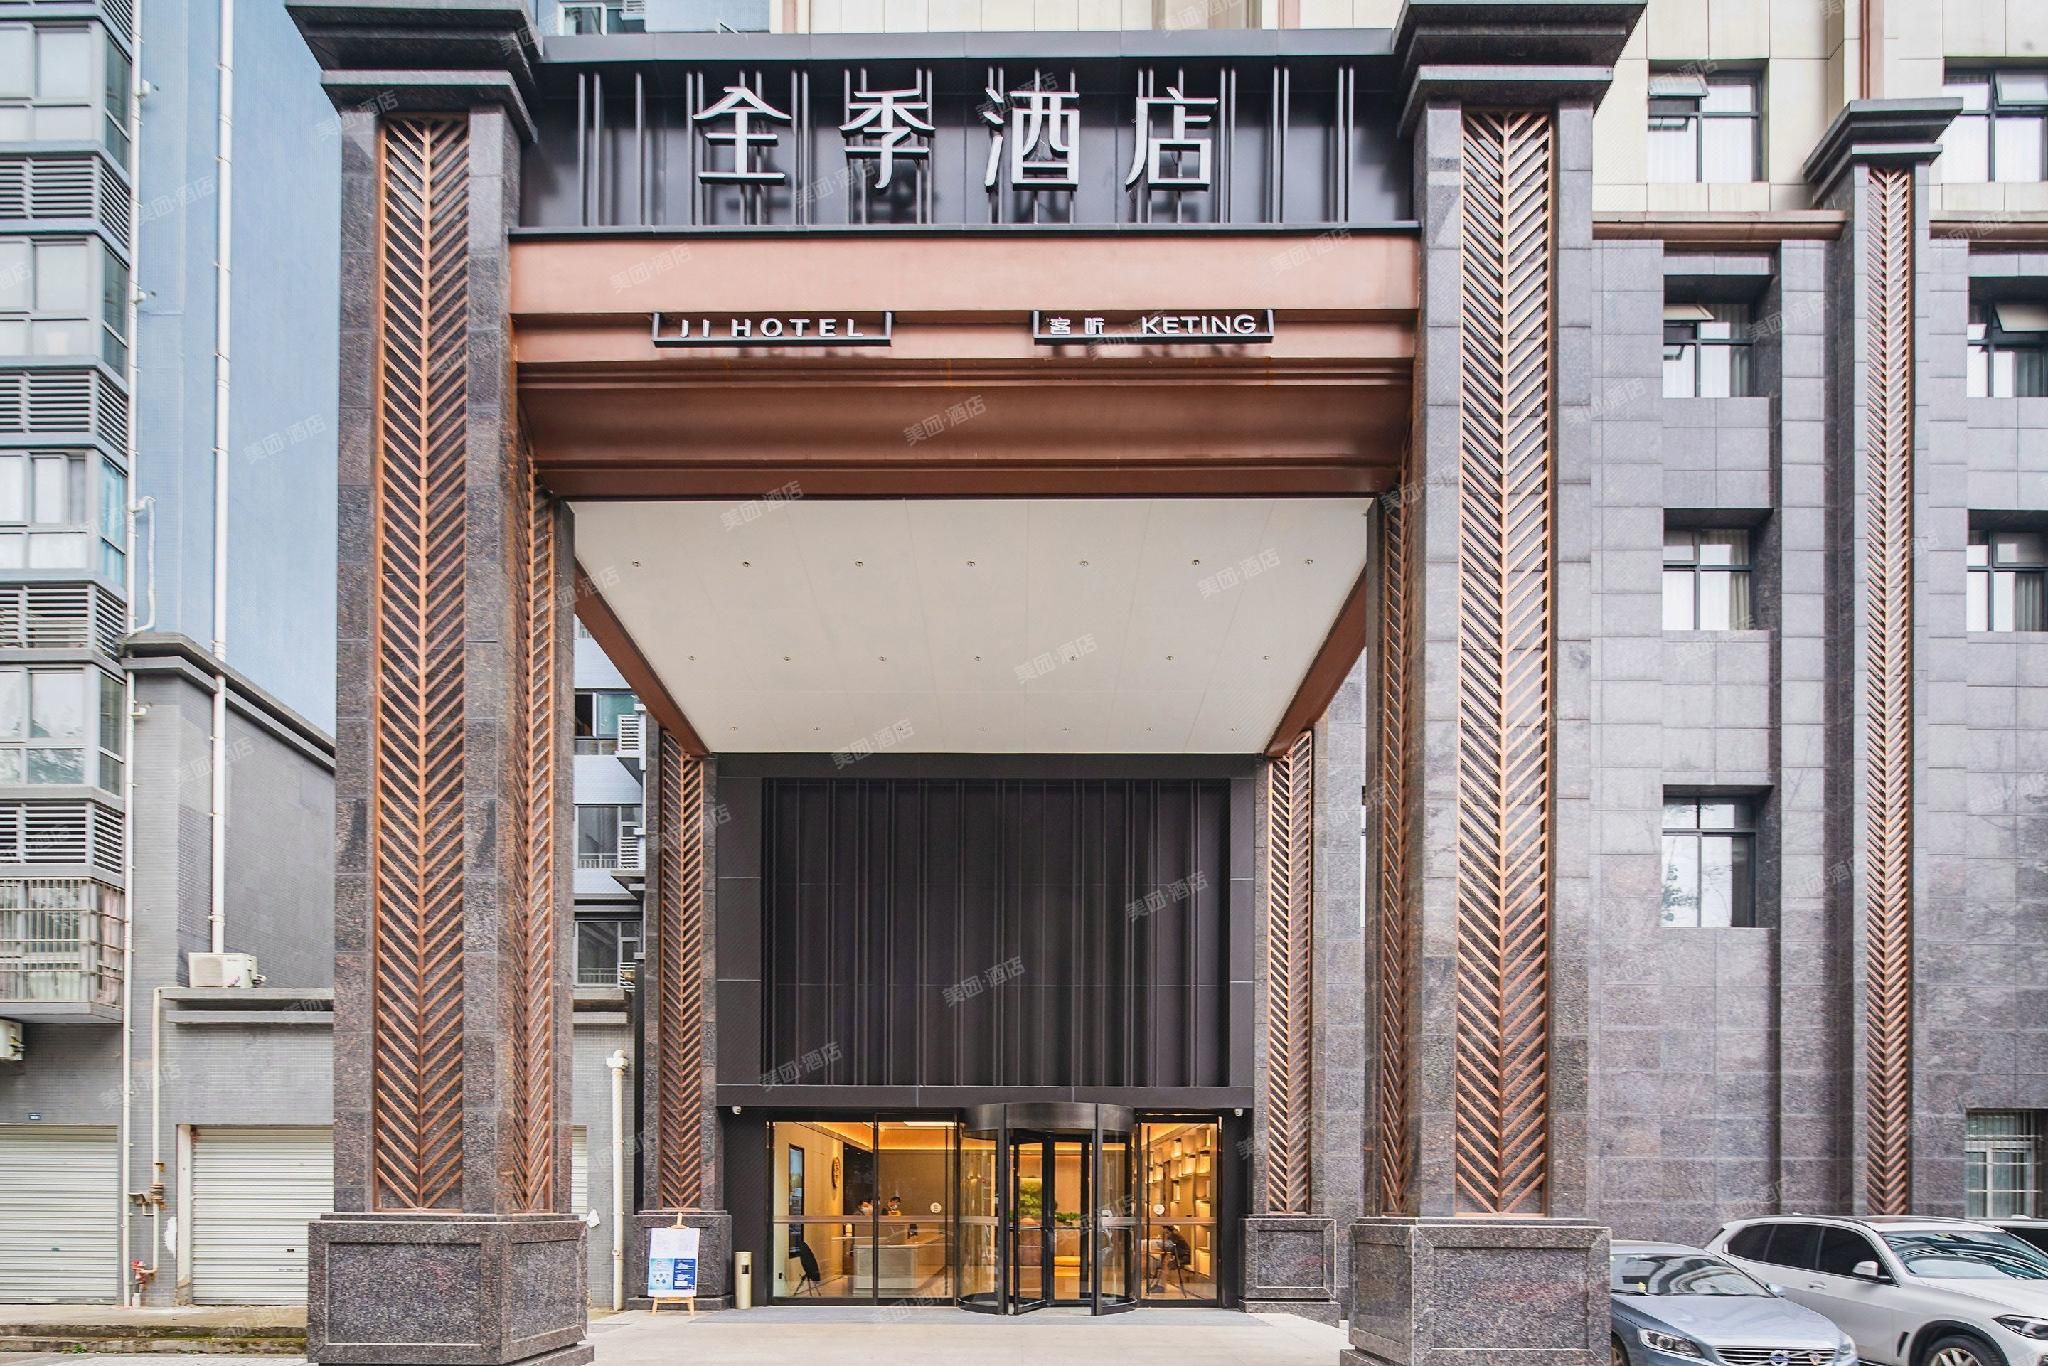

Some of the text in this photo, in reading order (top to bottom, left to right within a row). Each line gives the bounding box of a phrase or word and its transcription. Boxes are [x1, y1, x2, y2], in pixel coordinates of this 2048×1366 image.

[692, 86, 1218, 190] 全季酒店
[680, 318, 864, 338] JI HOTEL
[1142, 314, 1257, 335] KETING
